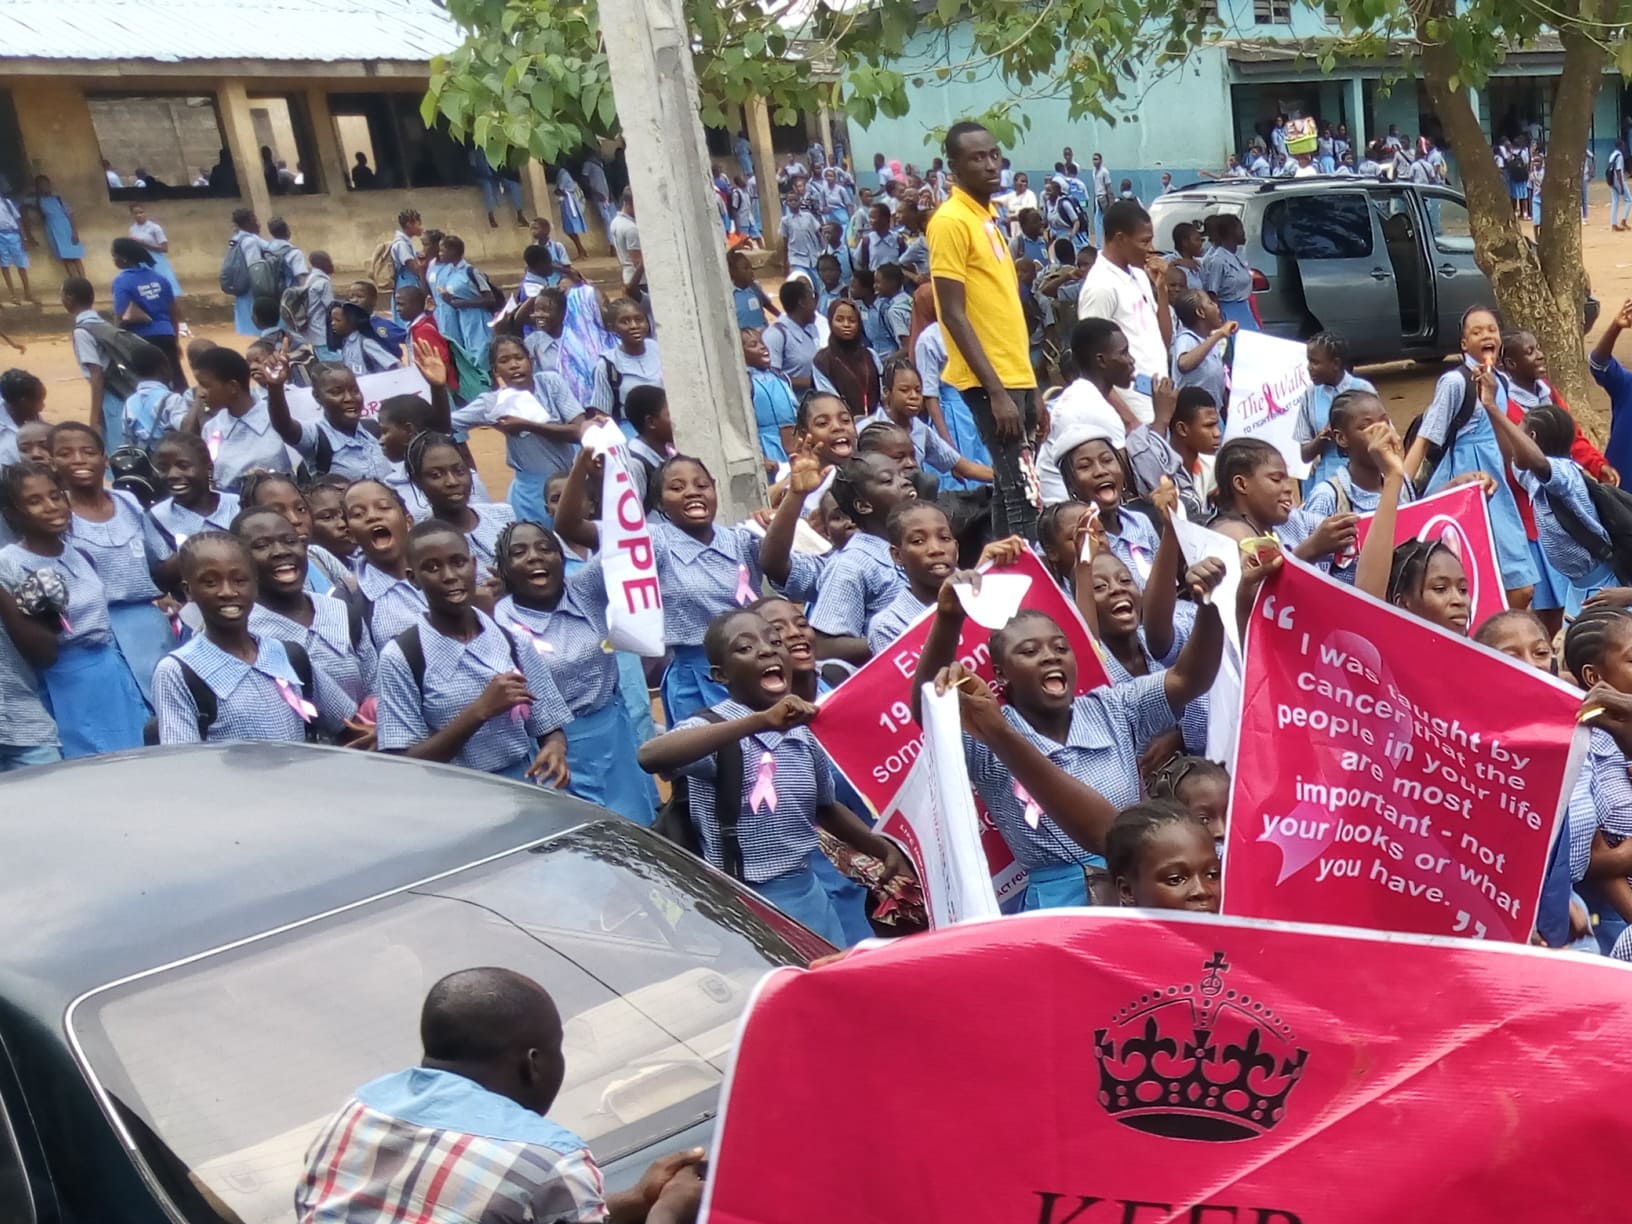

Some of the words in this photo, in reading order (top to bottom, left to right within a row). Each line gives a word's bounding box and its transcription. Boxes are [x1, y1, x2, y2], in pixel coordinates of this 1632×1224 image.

[1237, 391, 1264, 420] The
[1272, 364, 1307, 400] Walk
[608, 447, 661, 614] OPE
[879, 701, 912, 733] 19
[1297, 672, 1405, 723] cancer
[1414, 720, 1467, 769] that
[1474, 761, 1527, 792] the
[1300, 633, 1309, 655] I
[1319, 644, 1379, 684] was
[1388, 683, 1481, 753] taught
[1491, 739, 1531, 771] by
[1277, 703, 1376, 746] people
[1384, 732, 1414, 762] in
[1422, 752, 1491, 801] your
[1500, 791, 1543, 830] life
[1340, 750, 1384, 782] are
[1392, 777, 1473, 820] most
[1262, 813, 1330, 840] your
[1335, 819, 1404, 861] looks
[1414, 853, 1452, 874] or
[1459, 864, 1522, 920] what
[1296, 776, 1433, 838] important
[1461, 831, 1506, 874] not
[1315, 858, 1361, 882] you
[1369, 860, 1451, 906] have.
